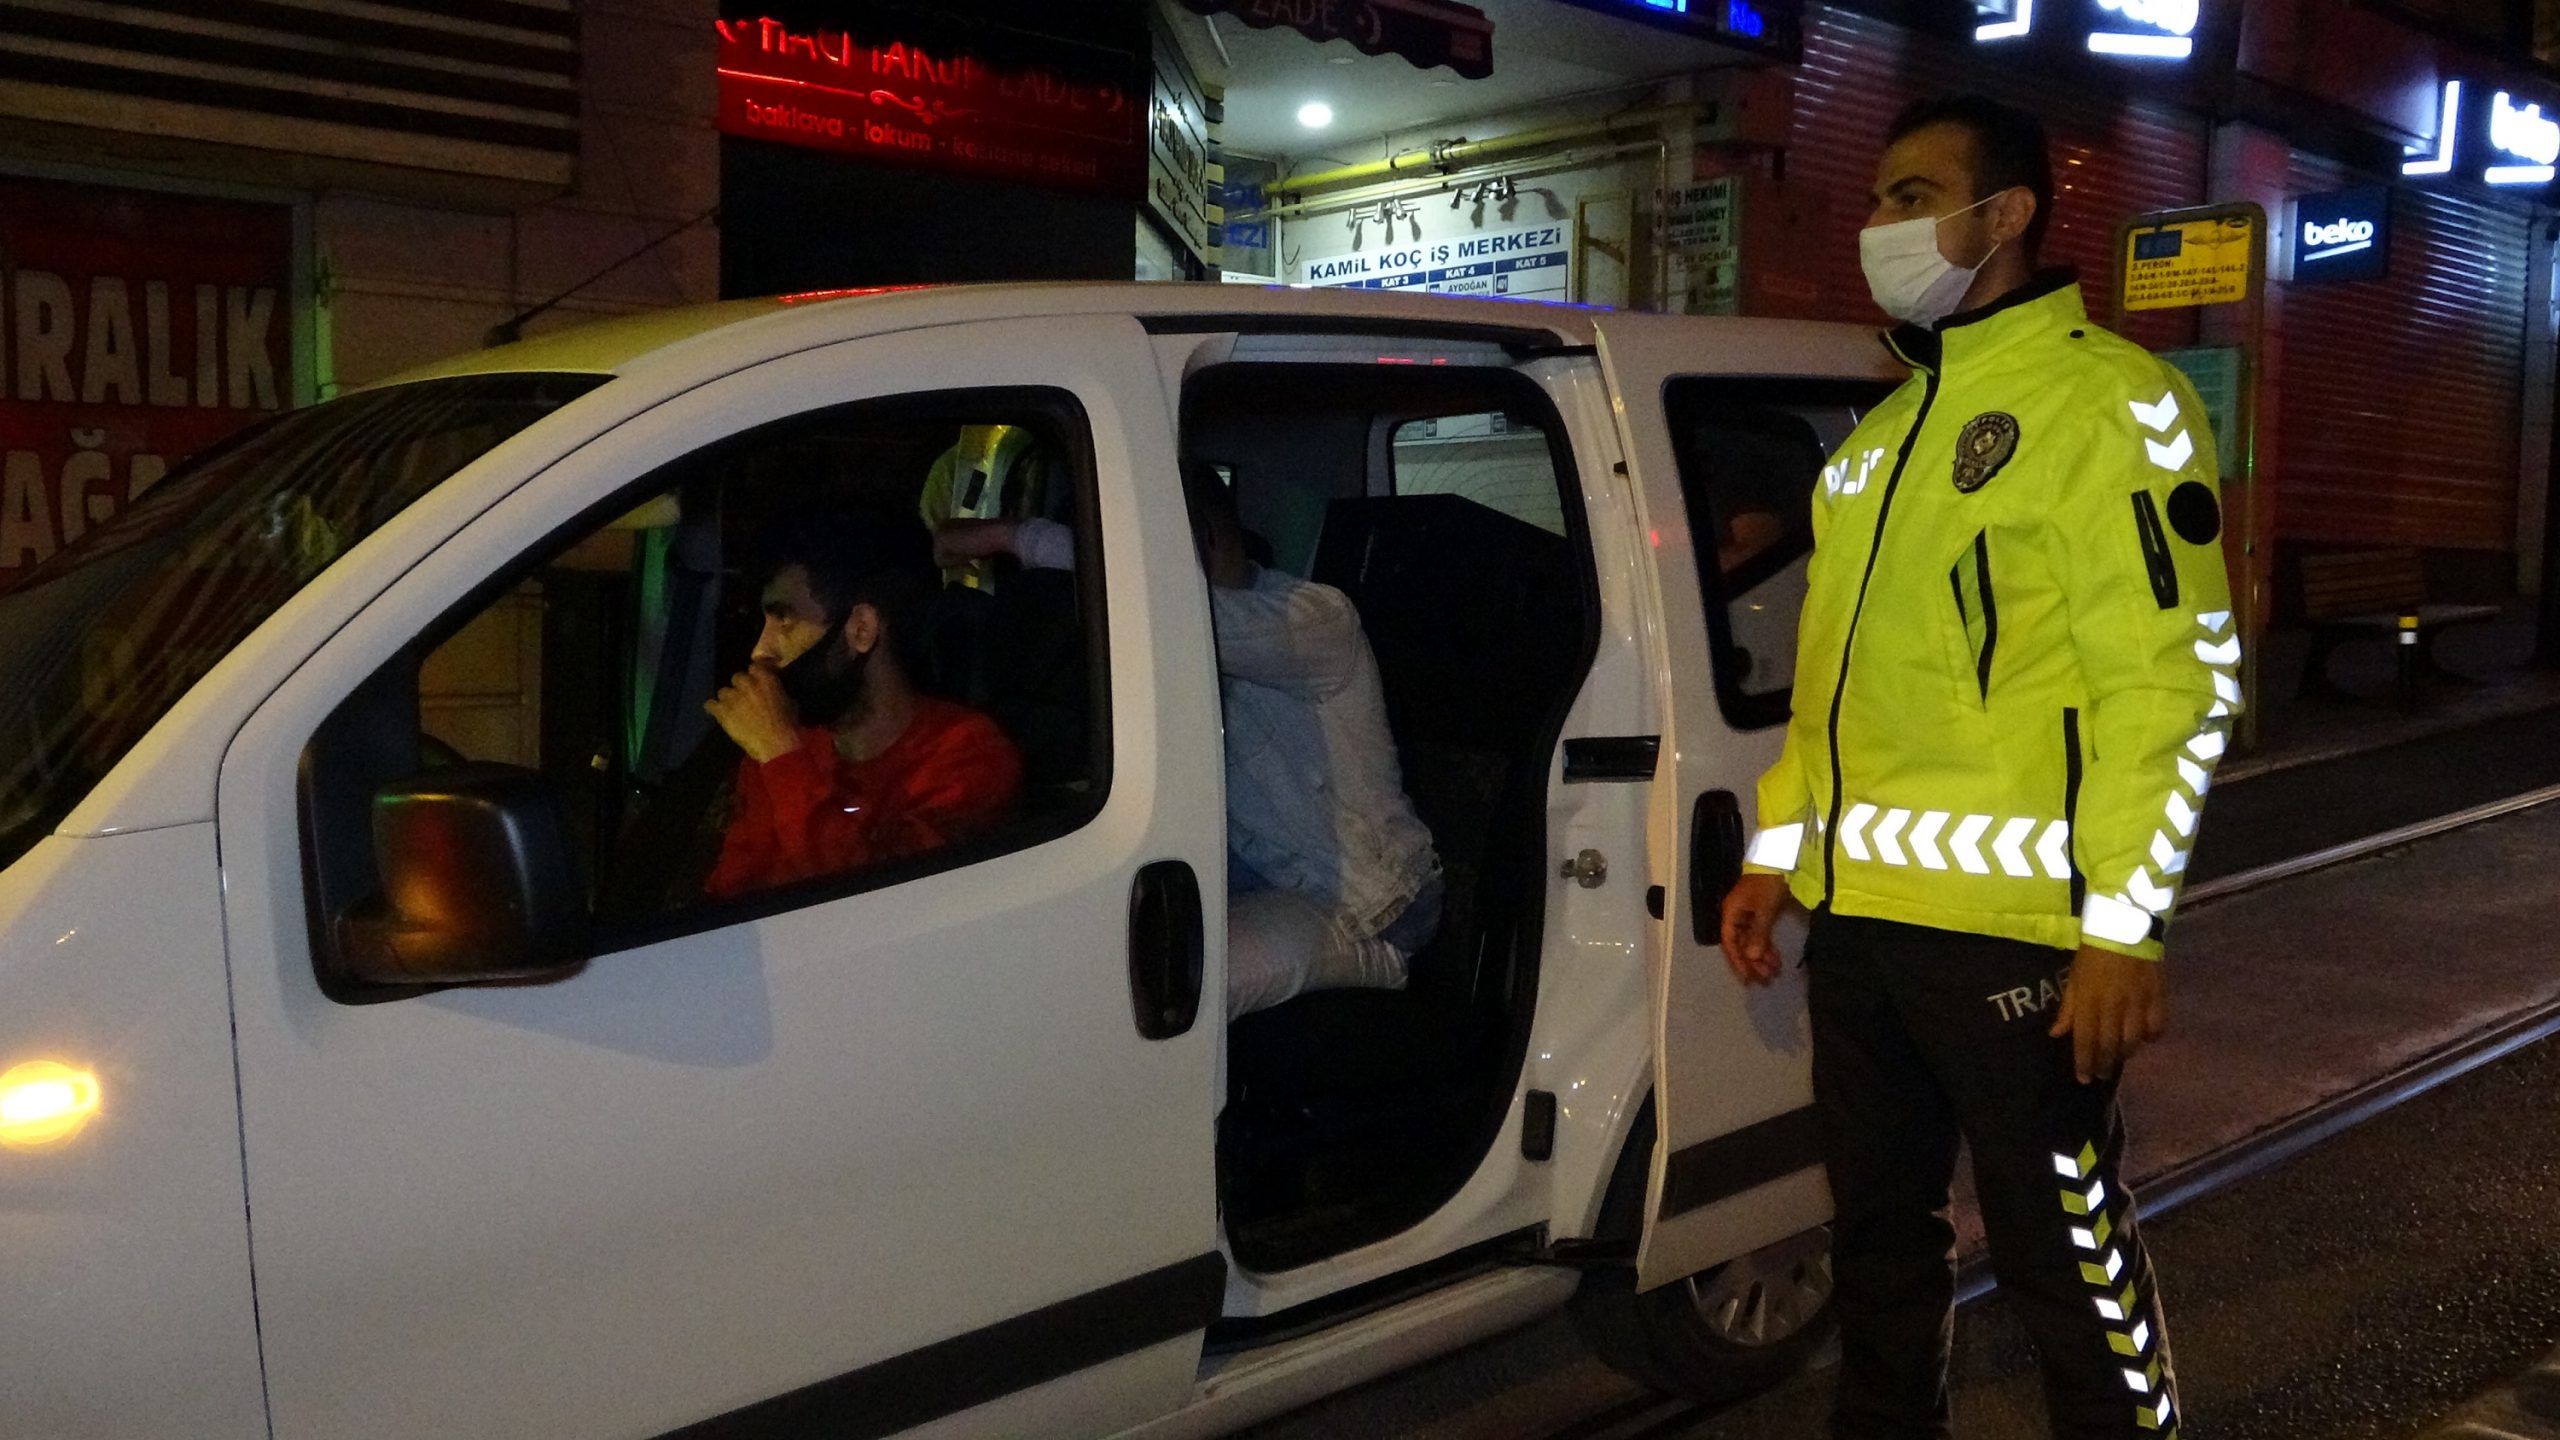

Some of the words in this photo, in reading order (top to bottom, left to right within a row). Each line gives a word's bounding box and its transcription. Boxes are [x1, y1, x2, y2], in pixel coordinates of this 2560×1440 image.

[864, 119, 931, 151] lokum
[2304, 218, 2374, 246] beko
[1380, 250, 1422, 269] KOÇ
[1515, 257, 1539, 268] KAT
[1445, 267, 1467, 279] KAT
[0, 268, 279, 411] RALIK
